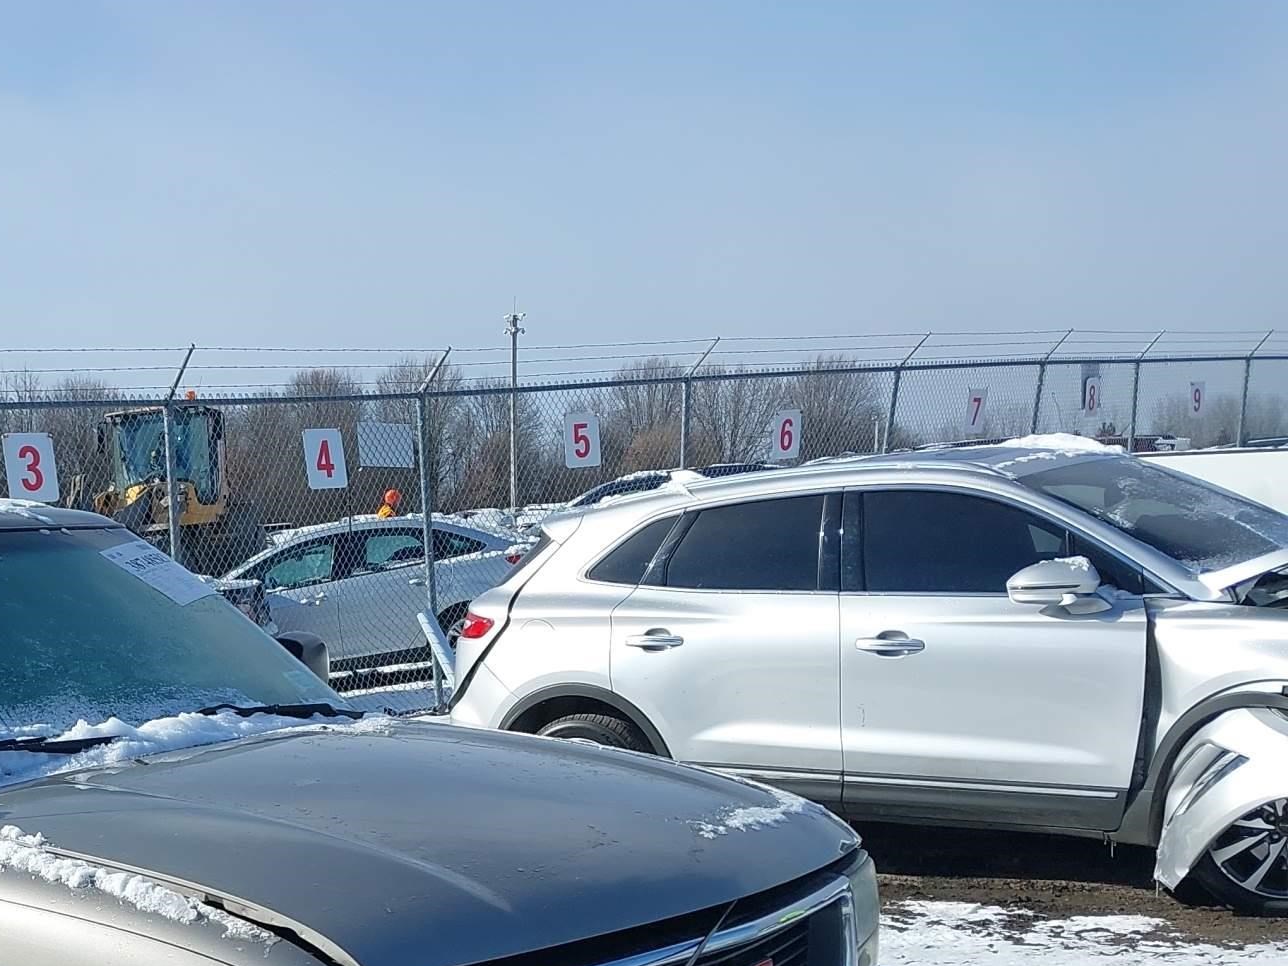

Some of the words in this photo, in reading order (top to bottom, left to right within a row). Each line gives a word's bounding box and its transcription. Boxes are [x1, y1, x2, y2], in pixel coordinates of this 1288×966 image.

[971, 397, 982, 426] 7
[1087, 384, 1097, 412] 8
[1193, 388, 1201, 412] 9
[573, 423, 591, 458] 5
[780, 418, 793, 451] 6
[19, 446, 44, 492] 3
[317, 440, 335, 478] 4
